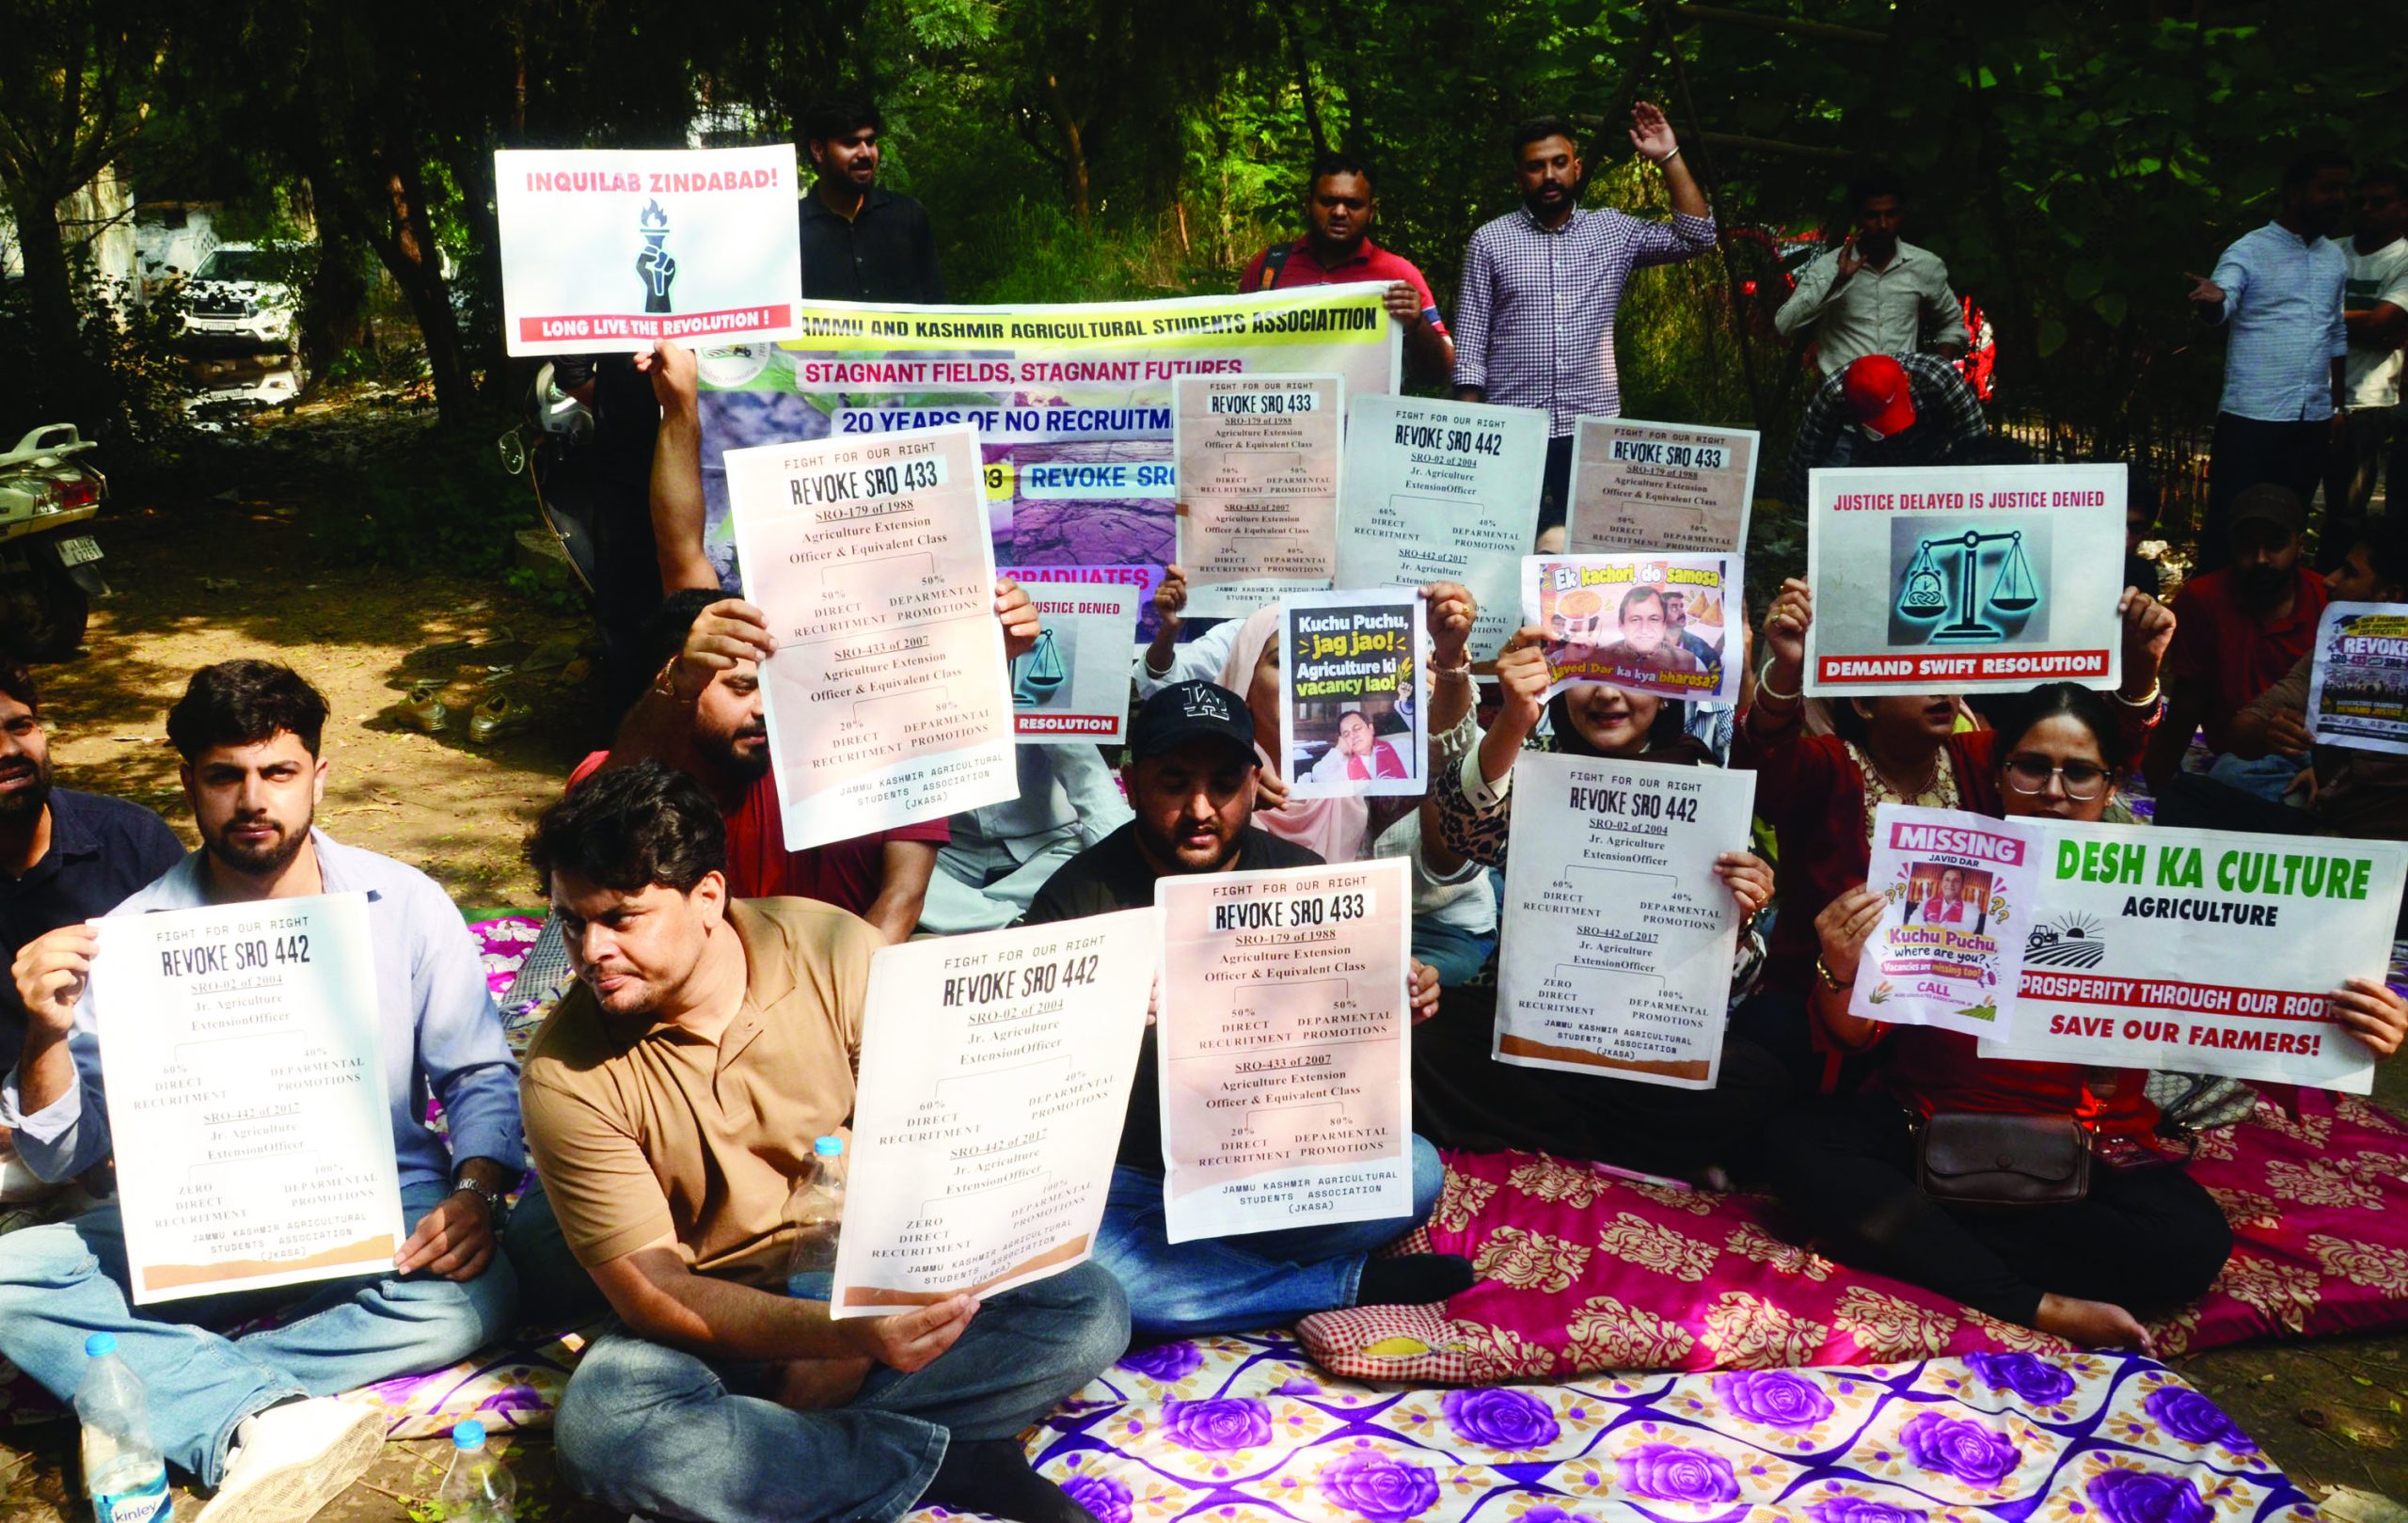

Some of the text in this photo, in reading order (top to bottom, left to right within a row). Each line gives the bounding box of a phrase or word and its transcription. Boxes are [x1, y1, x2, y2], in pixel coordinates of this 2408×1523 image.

[527, 168, 778, 192] INQUILAB ZINDABAD!
[543, 320, 588, 337] LONG
[594, 319, 627, 336] LIVE
[630, 320, 657, 336] THE
[663, 312, 759, 336] REVOLUTION
[802, 308, 1375, 338] AMMU AND KASHMIR AGRICULTURAL STUDENTS ASSOCIATTION
[806, 359, 1242, 385] STAGNANT FIELDS, STAGNANT FUTURES
[1212, 394, 1311, 414] REVOKE SRO 433
[844, 408, 1173, 433] 20 YEARS OF NO RECRUITM
[1395, 424, 1502, 455] REVOKE SRO 442
[1614, 441, 1720, 468] REVOKE SRO 433
[791, 461, 938, 506] REVOKE SRO 433
[1032, 467, 1125, 487] REVOKE
[1834, 491, 2104, 510] JUSTICE DELAYED IS JUSTICE DENIED
[1006, 569, 1149, 590] GRADUATES
[1555, 563, 1719, 591] Ek kachori, do samosa
[1079, 603, 1119, 614] DENIED
[1299, 614, 1408, 632] Kuchu Puchu,
[1313, 631, 1394, 659] jag jao!
[2344, 638, 2408, 657] REVOKE
[1297, 658, 1397, 680] Agriculture ki
[1591, 661, 1613, 674] Dar
[1617, 666, 1632, 678] ka
[1634, 669, 1656, 683] kya
[1659, 671, 1719, 690] bharosa?
[1827, 656, 2101, 675] DEMAND SWIFT RESOLUTION
[1296, 676, 1396, 696] vacancy lao!
[1020, 719, 1112, 730] RESOLUTION
[1570, 771, 1703, 792] FIGHT FOR OUR RIGHT
[1570, 787, 1697, 823] REVOKE SRO 442
[1589, 818, 1668, 835] SRO-02 of 2004
[1589, 834, 1665, 850] Jr. Agriculture
[1898, 826, 2016, 861] MISSING
[1583, 849, 1668, 866] ExtensionOfficer
[1928, 854, 1979, 867] JAVID DAR
[2056, 840, 2371, 899] DESH KA CULTURE
[1213, 877, 1367, 896] FIGHT FOR OUR RIGHT
[1215, 895, 1364, 930] REVOKE SRO 433
[2122, 896, 2278, 927] AGRICULTURE
[1235, 928, 1337, 945] SRO-179 of 1988
[1889, 928, 1997, 953] Kuchu Puchu,
[163, 935, 310, 976] REVOKE SRO 442
[1220, 945, 1351, 964] Agriculture Extension
[1895, 945, 1986, 963] where are you?
[1204, 962, 1366, 982] Officer & Equivalent Class
[1883, 962, 1919, 972] Vacancies
[1932, 964, 1961, 976] missing
[1964, 968, 1982, 977] too!
[943, 954, 1098, 1007] REVOKE SRO 442
[1917, 981, 1950, 996] CALL
[1333, 1000, 1357, 1010] 50%
[2019, 974, 2333, 1018] PROSPERITY THROUGH OUR ROOT
[1222, 1011, 1392, 1033] DIRECT DEPARMENTAL
[1231, 1007, 1256, 1017] 50%
[1199, 1025, 1387, 1050] RECURITMENT PROMOTIONS
[2050, 1015, 2321, 1055] SAVE OUR FARMERS!
[1235, 1054, 1331, 1073] SRO-433 of 2007
[1223, 1172, 1398, 1194] JAMMU KASHMIR AGRICULTURAL
[1240, 1185, 1382, 1205] STUDENTS ASSOCIATION
[1289, 1201, 1334, 1214] (JKASA)
[115, 1501, 156, 1521] kinley
